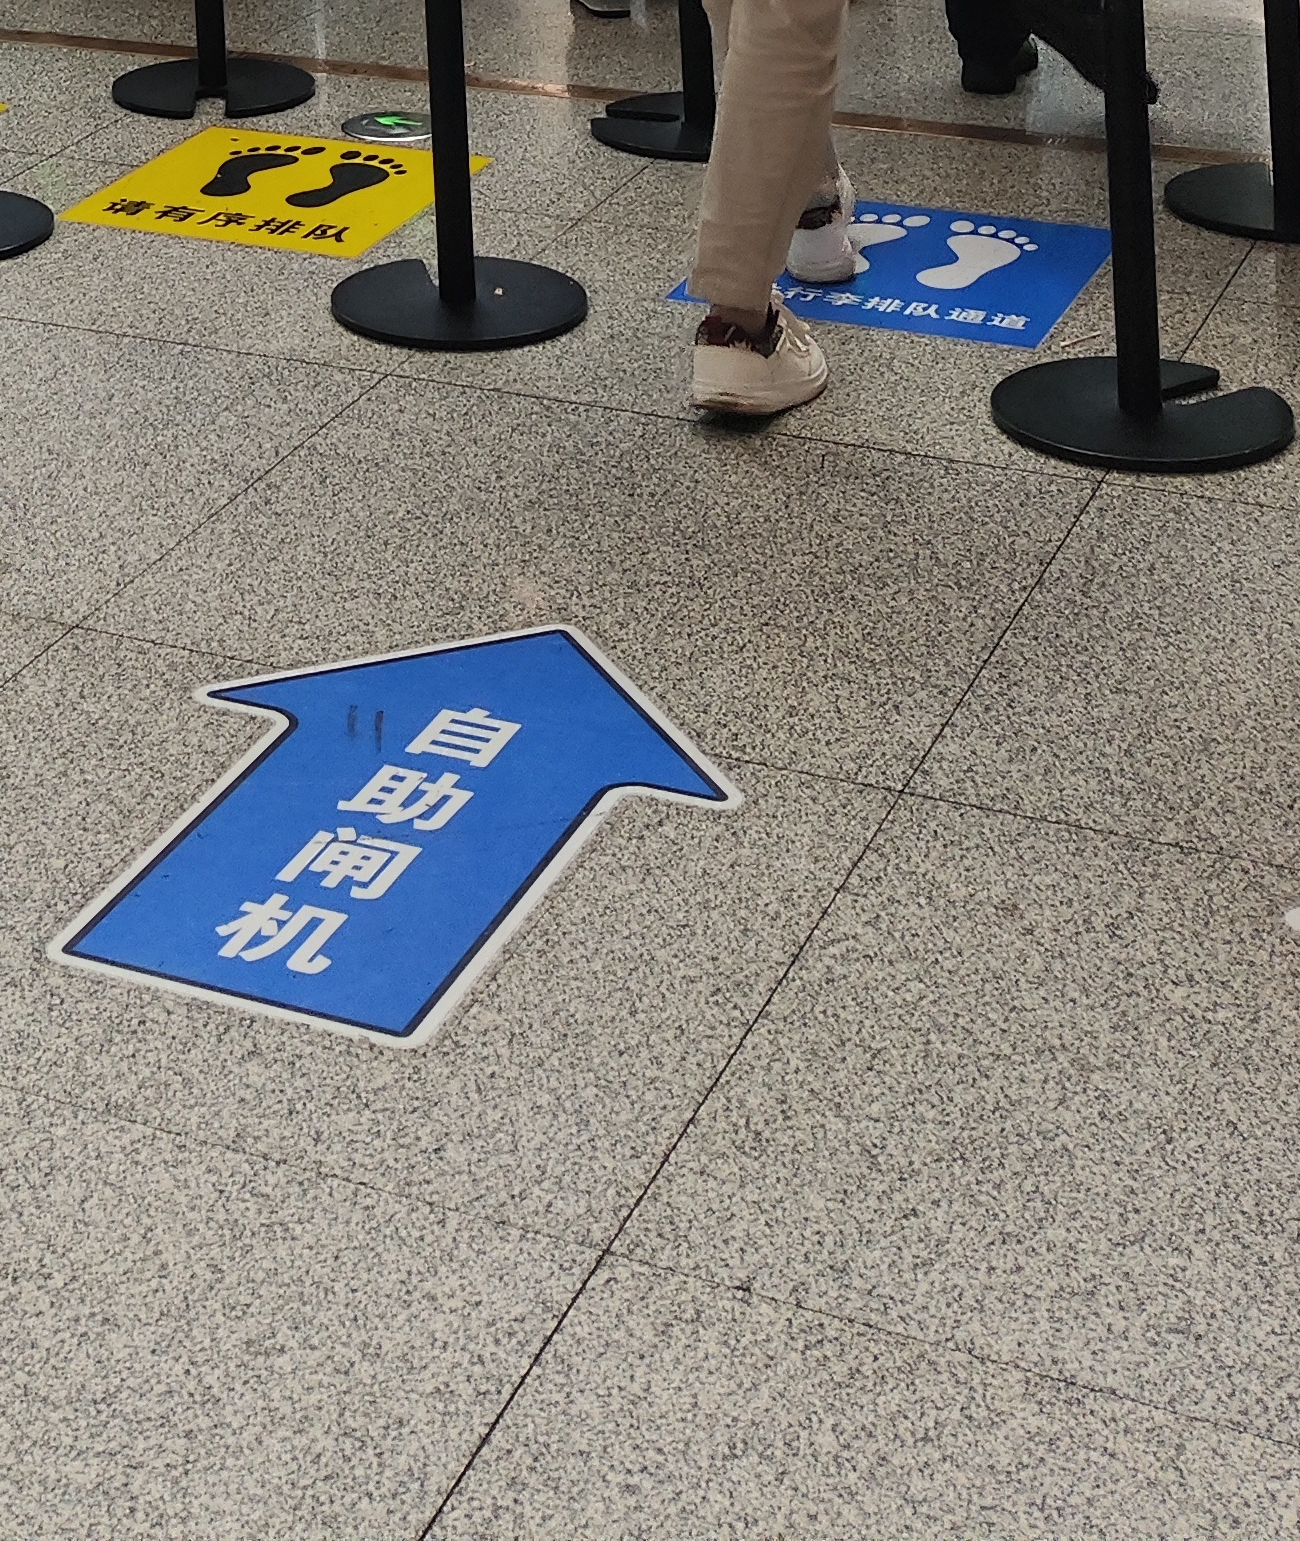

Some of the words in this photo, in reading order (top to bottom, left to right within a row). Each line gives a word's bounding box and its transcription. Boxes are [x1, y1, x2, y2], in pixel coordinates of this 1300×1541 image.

[101, 196, 348, 244] 请有序排队
[772, 282, 1030, 330] 行李排队通道
[215, 707, 522, 975] 自助闸机
